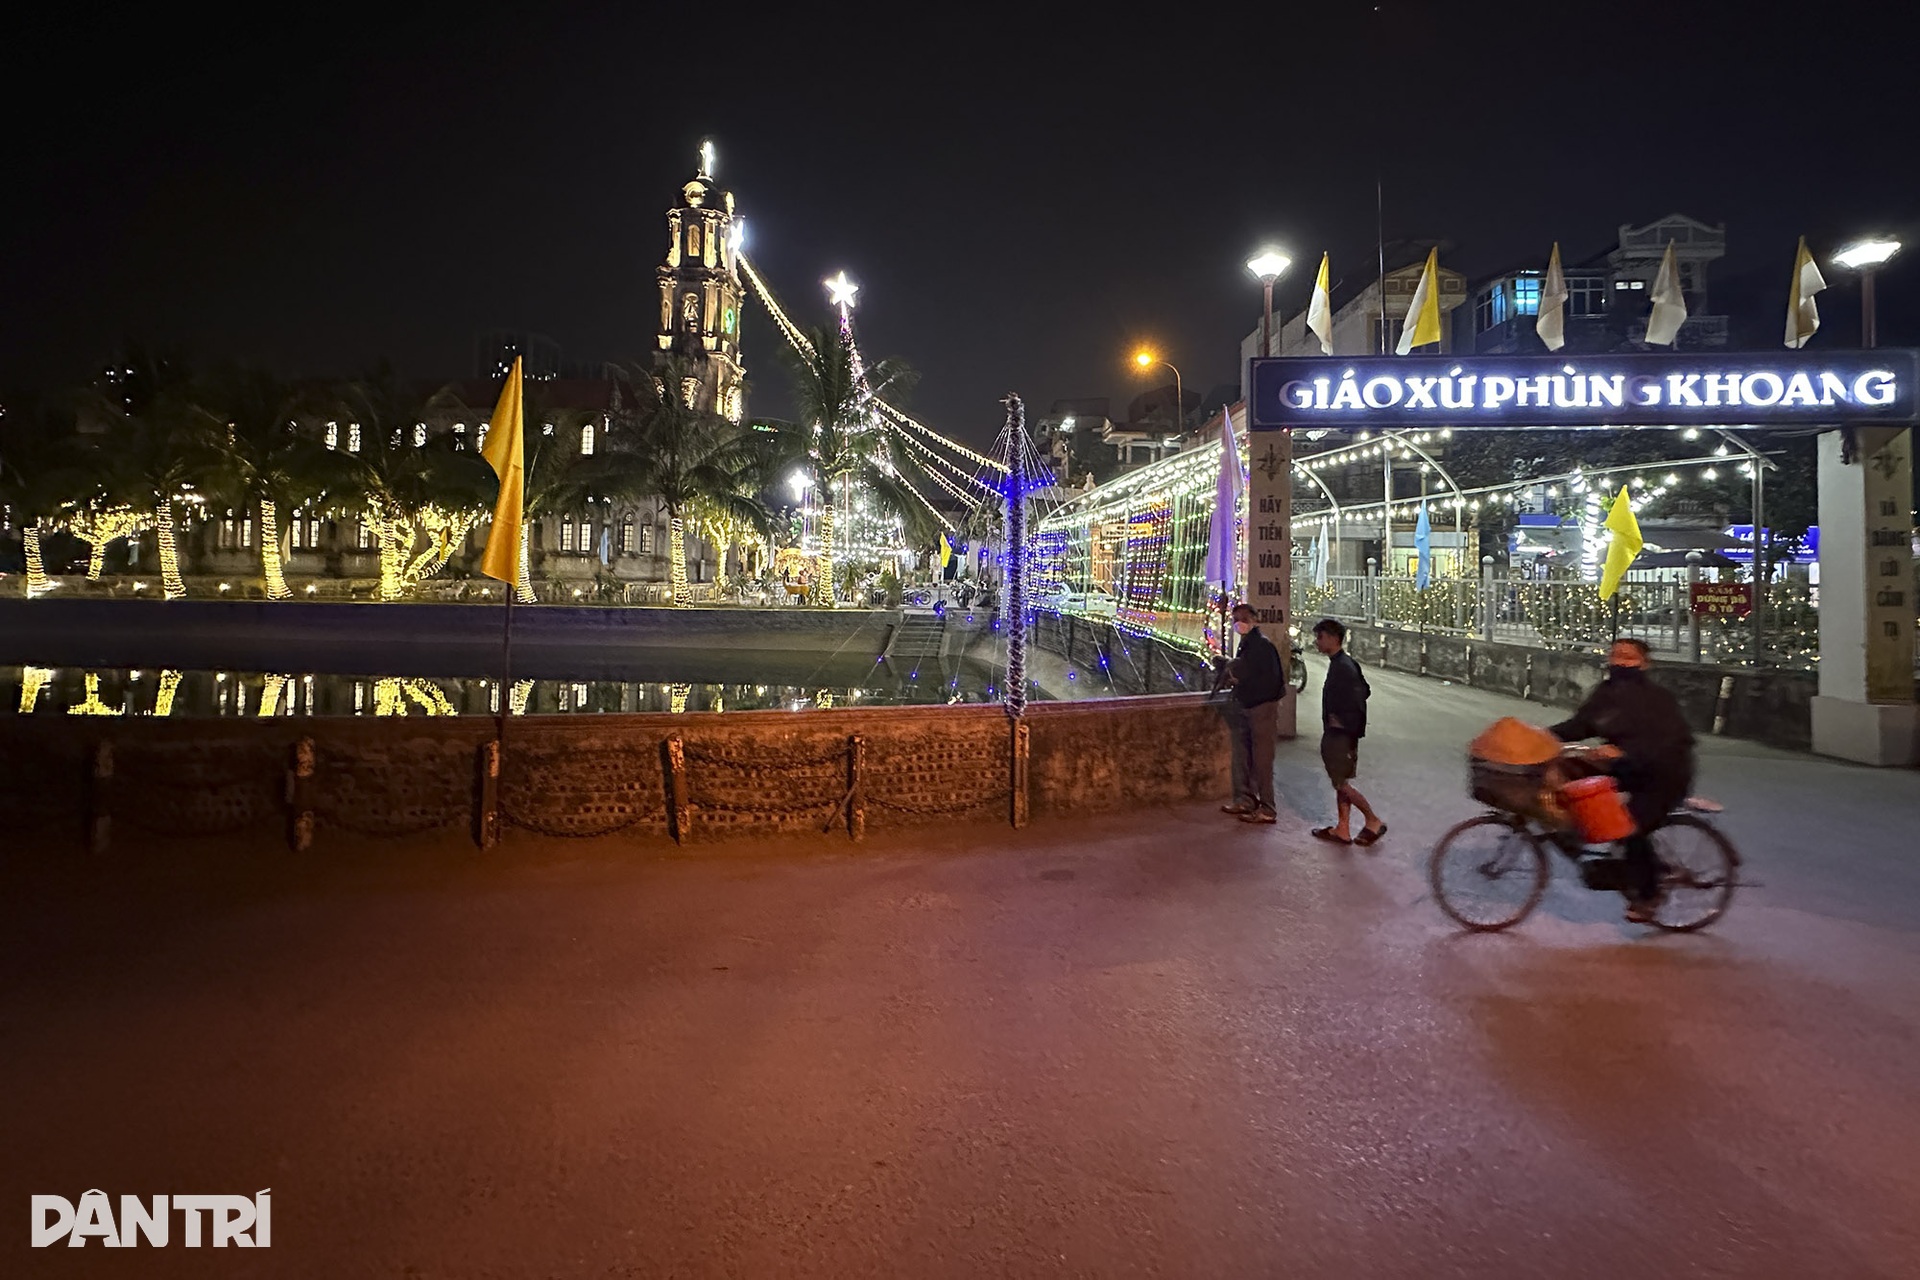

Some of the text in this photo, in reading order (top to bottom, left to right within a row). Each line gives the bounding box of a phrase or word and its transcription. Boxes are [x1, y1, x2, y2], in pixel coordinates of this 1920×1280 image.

[1279, 365, 1897, 409] GIÁO XỨ PHÙNG KHOANG
[1259, 495, 1282, 513] HÃY
[1258, 519, 1283, 541] TIẾN
[1259, 549, 1282, 569] VÀO
[1258, 577, 1282, 597] NHÀ
